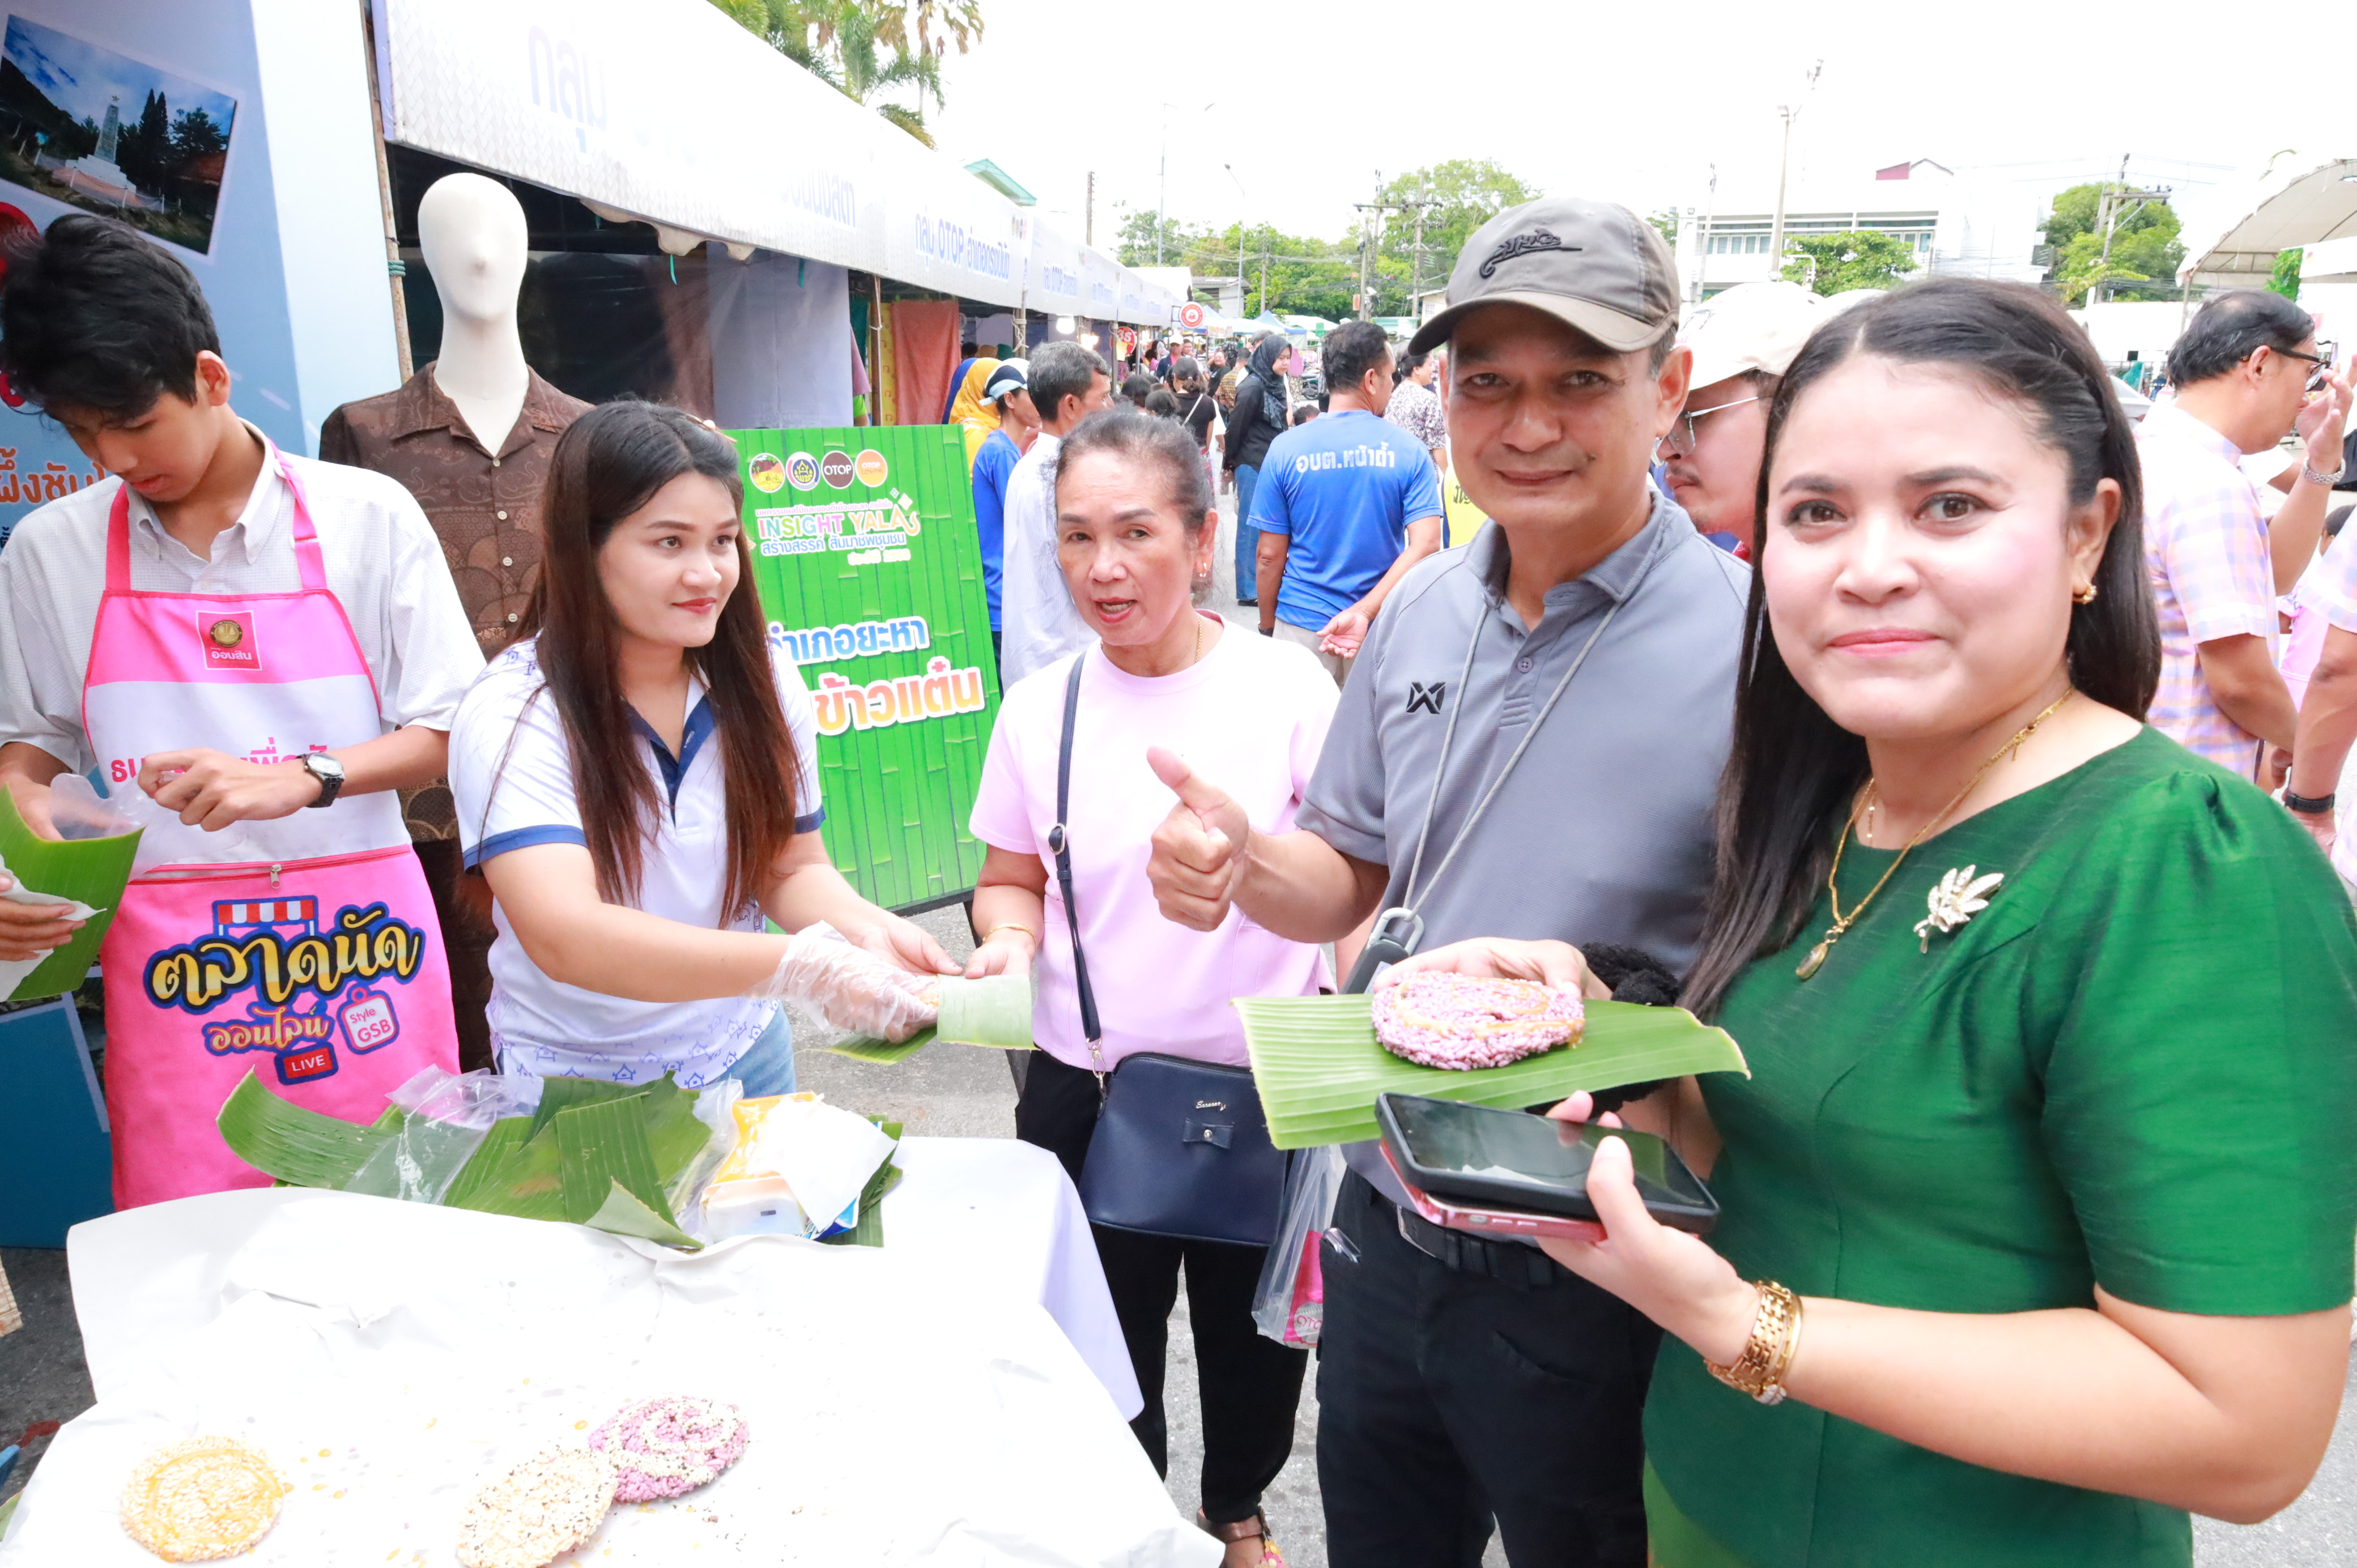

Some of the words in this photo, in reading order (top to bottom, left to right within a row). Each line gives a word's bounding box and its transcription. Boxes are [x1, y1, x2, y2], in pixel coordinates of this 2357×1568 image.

[915, 204, 934, 267] กลุ่ม
[938, 218, 964, 266] OTOP
[1296, 441, 1395, 473] อบต.หน้าถ้ำ
[823, 465, 853, 476] OTOP
[759, 514, 844, 538] INSIGHT
[850, 504, 920, 535] YALA
[762, 534, 824, 555] สร้างสรรค์
[830, 532, 905, 550] สัมมาชีพชุมชน
[211, 649, 253, 661] ออมสิน
[148, 907, 423, 1008] ตลาดนัด
[349, 1007, 376, 1025] Style
[210, 1006, 328, 1050] ออนไลน์
[358, 1020, 392, 1043] GSB
[291, 1054, 326, 1072] LIVE
